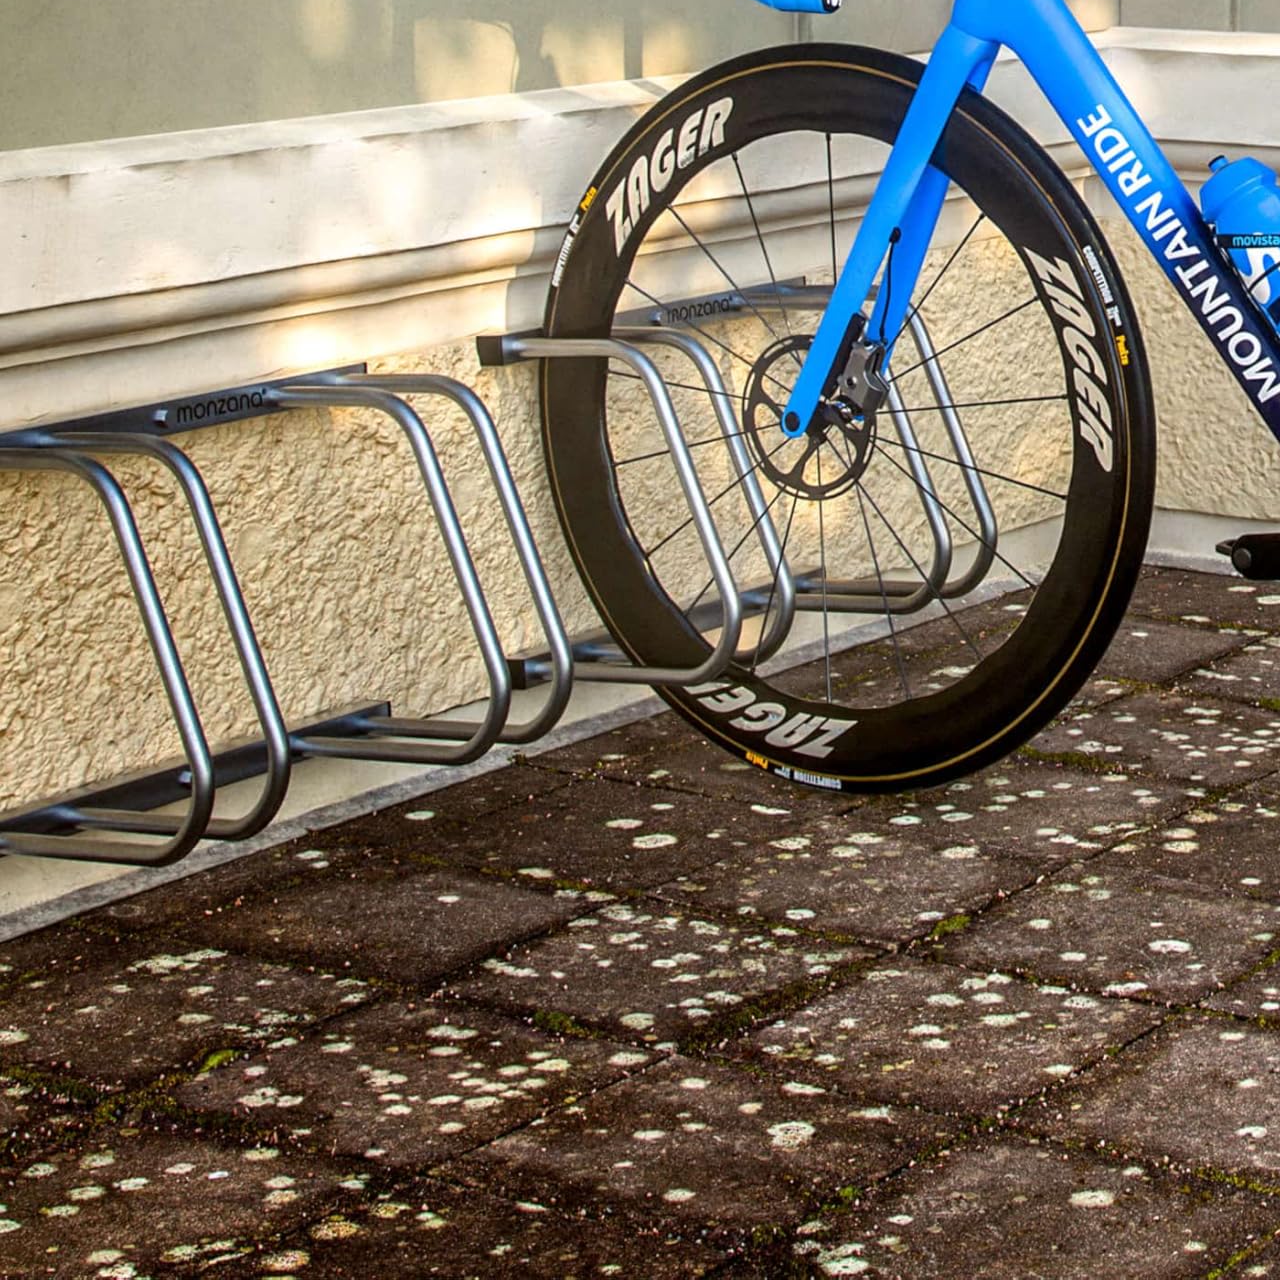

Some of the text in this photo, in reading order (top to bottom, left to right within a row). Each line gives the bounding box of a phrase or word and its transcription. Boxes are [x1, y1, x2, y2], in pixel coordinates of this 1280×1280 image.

[605, 96, 734, 257] ZAGER
[1076, 104, 1153, 198] RIDE
[1022, 246, 1113, 472] ZAGER
